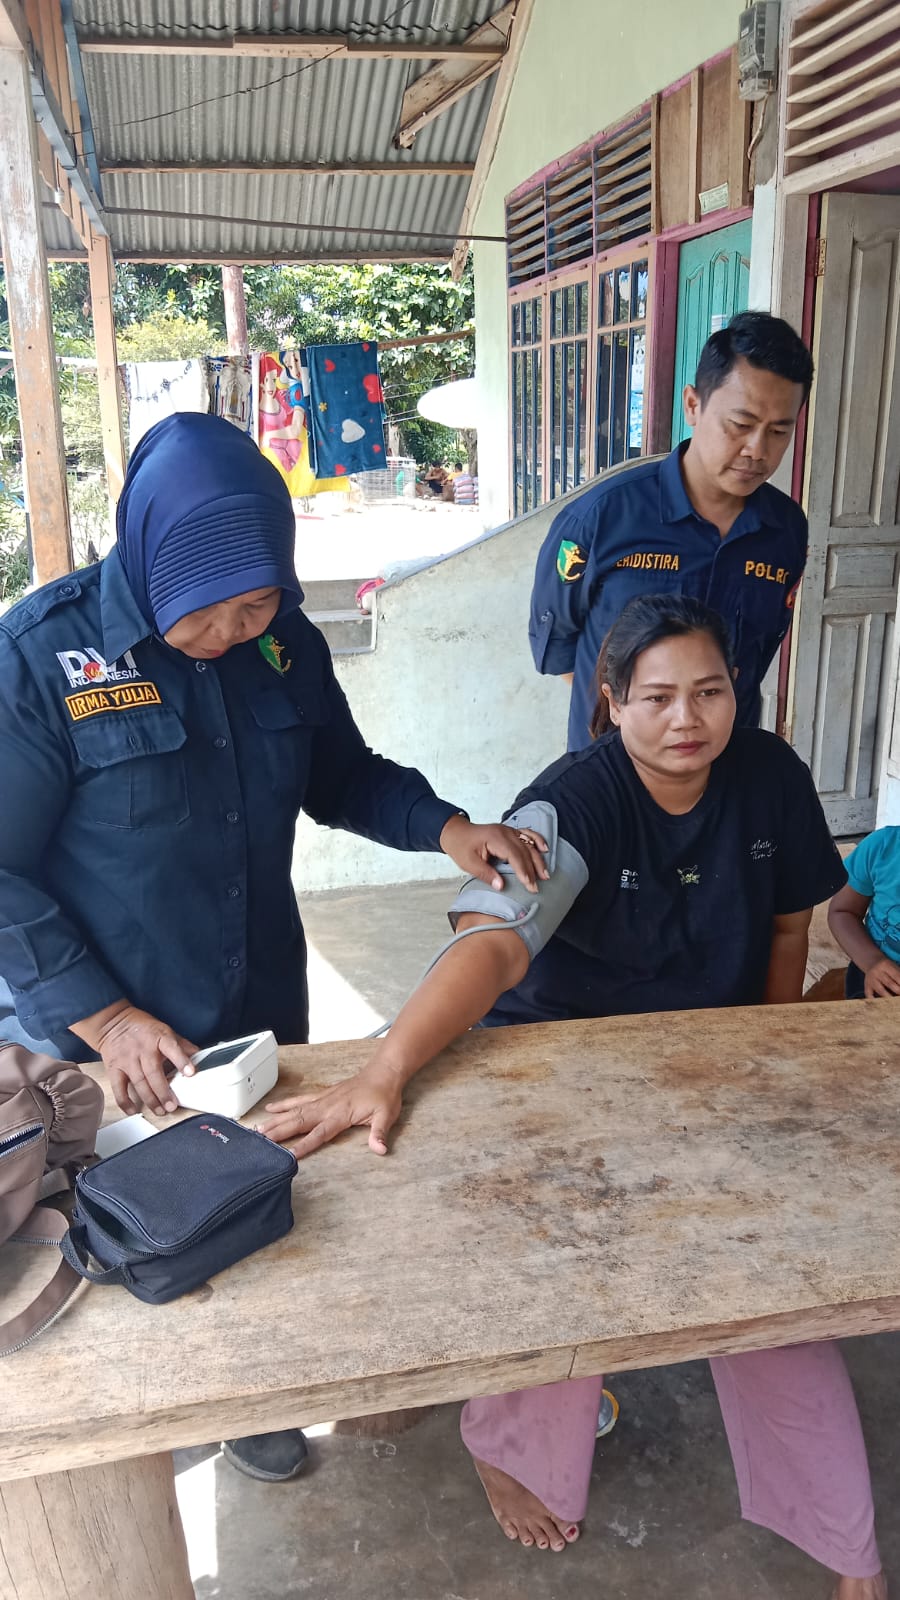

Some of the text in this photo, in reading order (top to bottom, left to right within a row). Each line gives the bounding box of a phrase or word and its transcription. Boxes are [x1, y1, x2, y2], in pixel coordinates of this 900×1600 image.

[744, 560, 790, 585] POLRI
[69, 668, 142, 689] INDONESIA
[71, 686, 155, 716] IRMA YULIA
